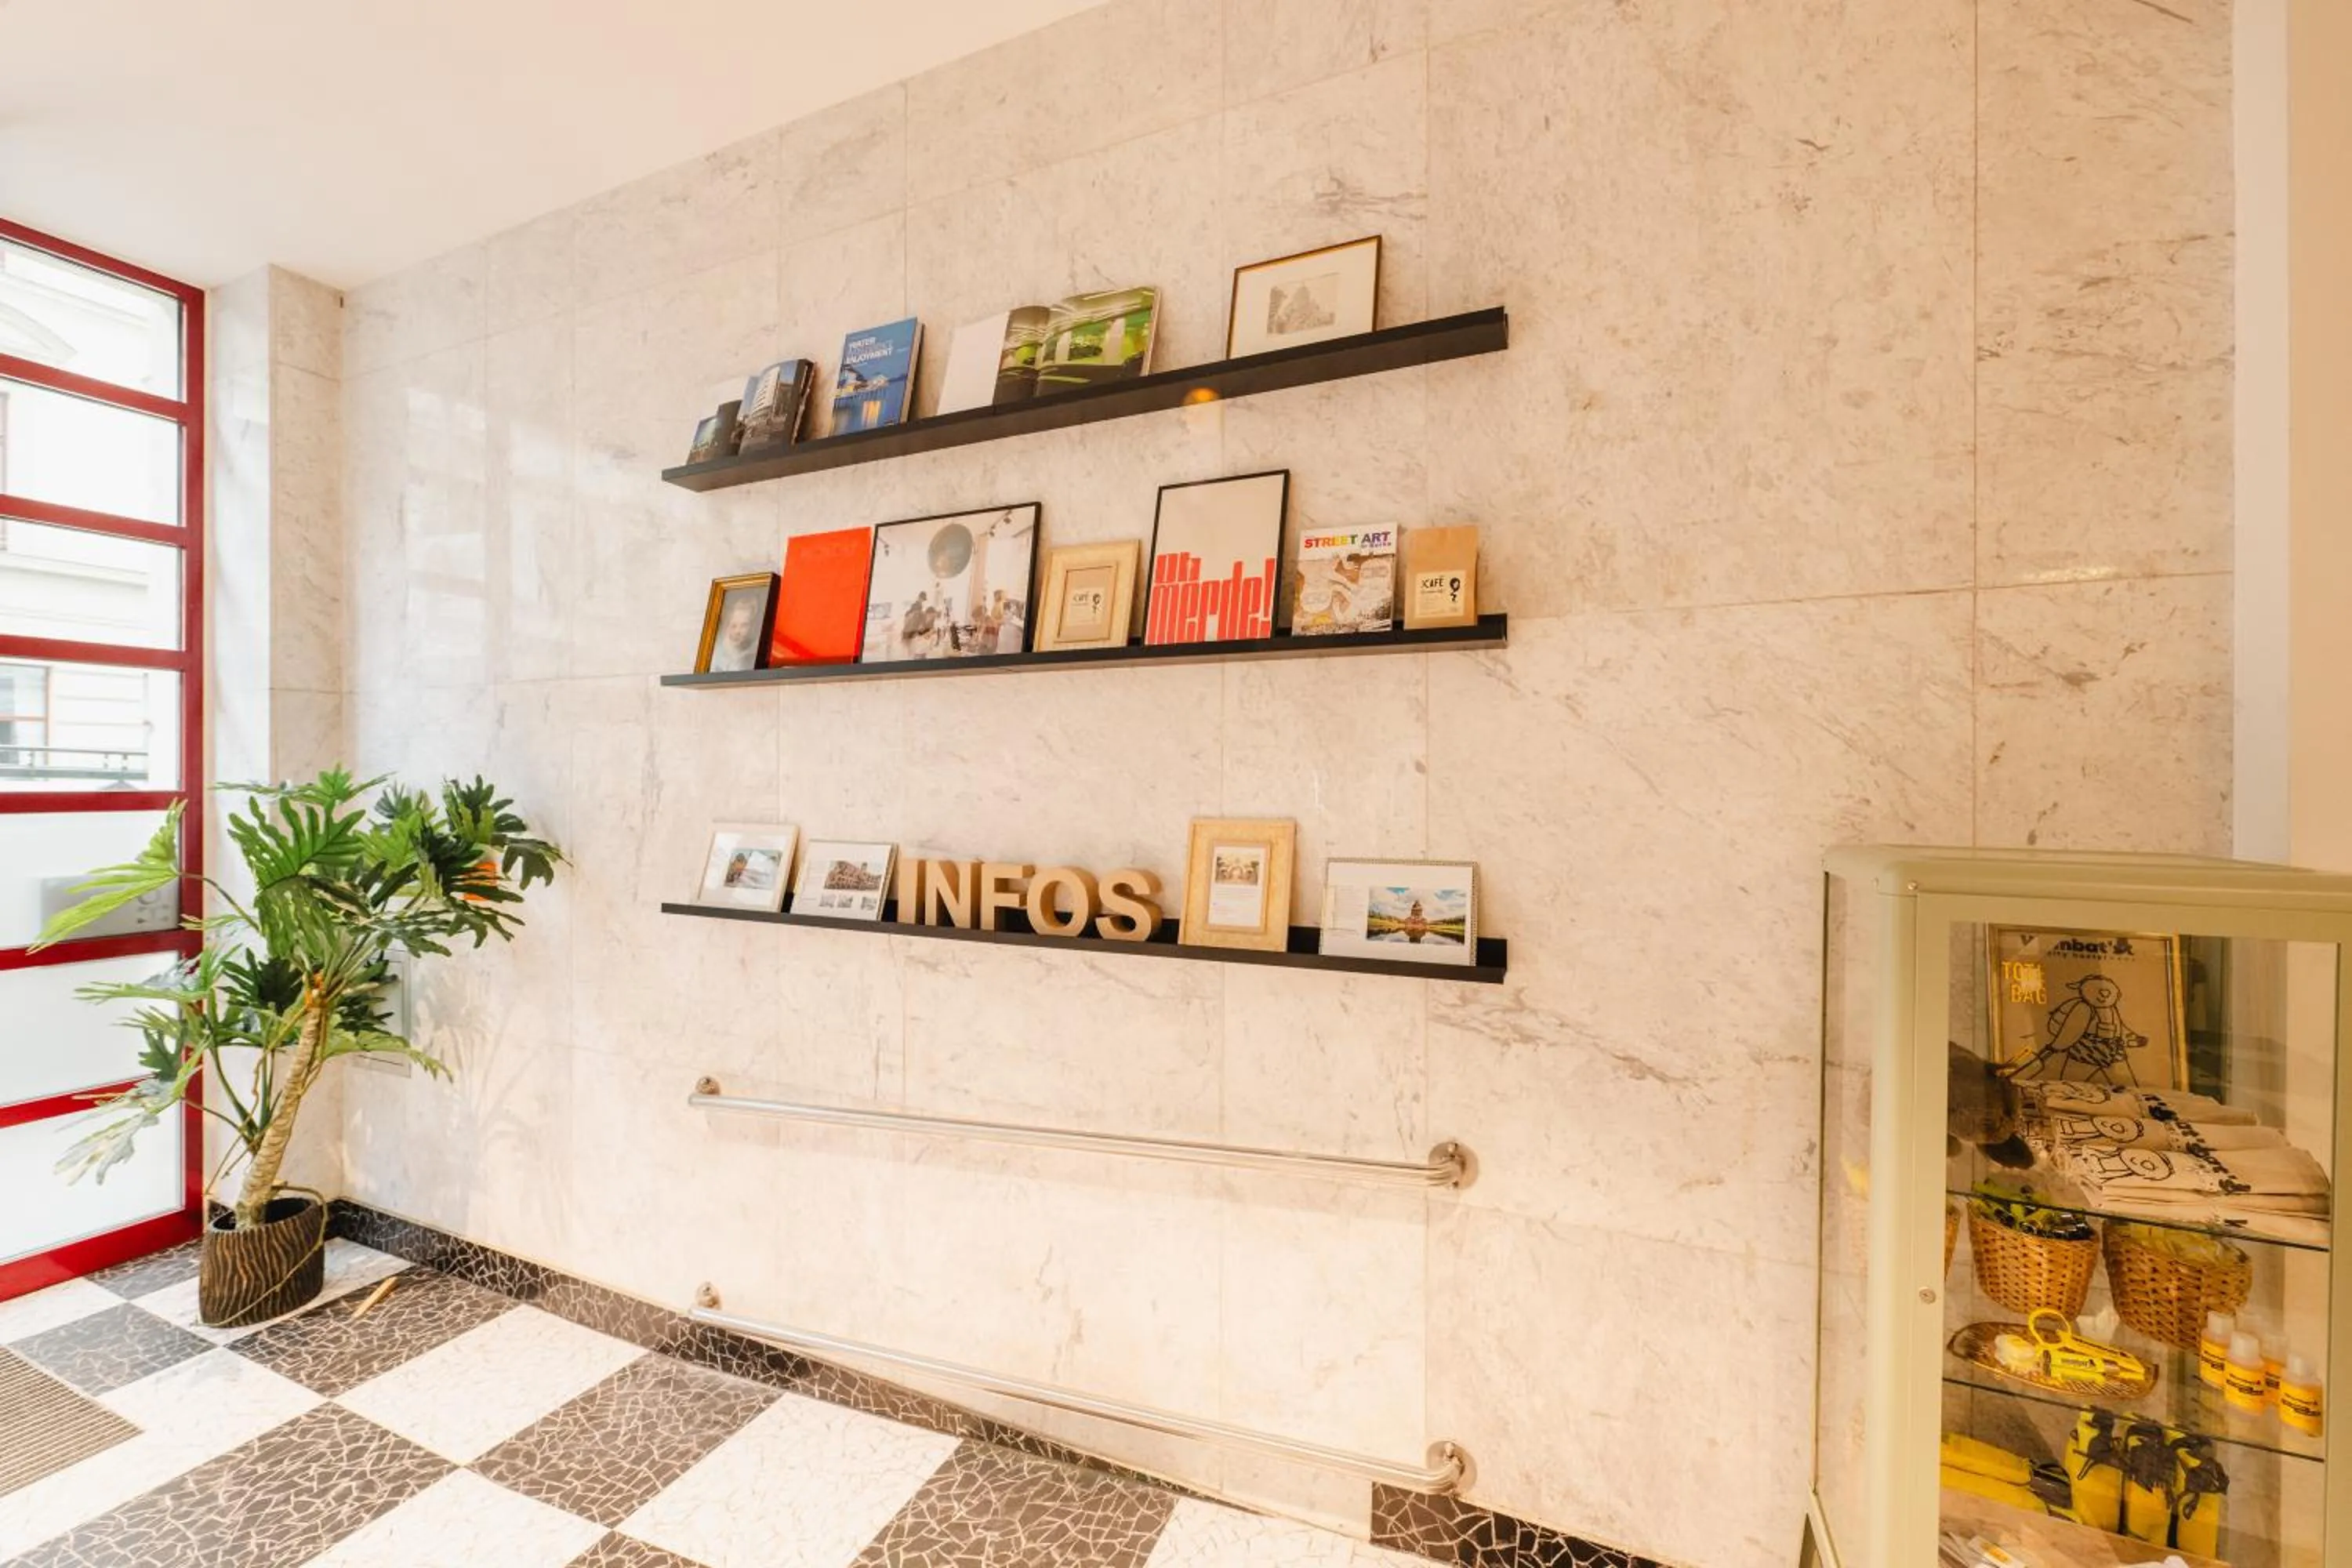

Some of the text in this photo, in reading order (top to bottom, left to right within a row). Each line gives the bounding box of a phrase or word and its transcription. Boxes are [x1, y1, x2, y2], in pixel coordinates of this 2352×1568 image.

[1305, 535, 1358, 549] STREET
[1361, 532, 1391, 543] ART
[1146, 557, 1276, 645] merde!
[897, 858, 1162, 941] INFOS
[2011, 984, 2047, 1004] BAG
